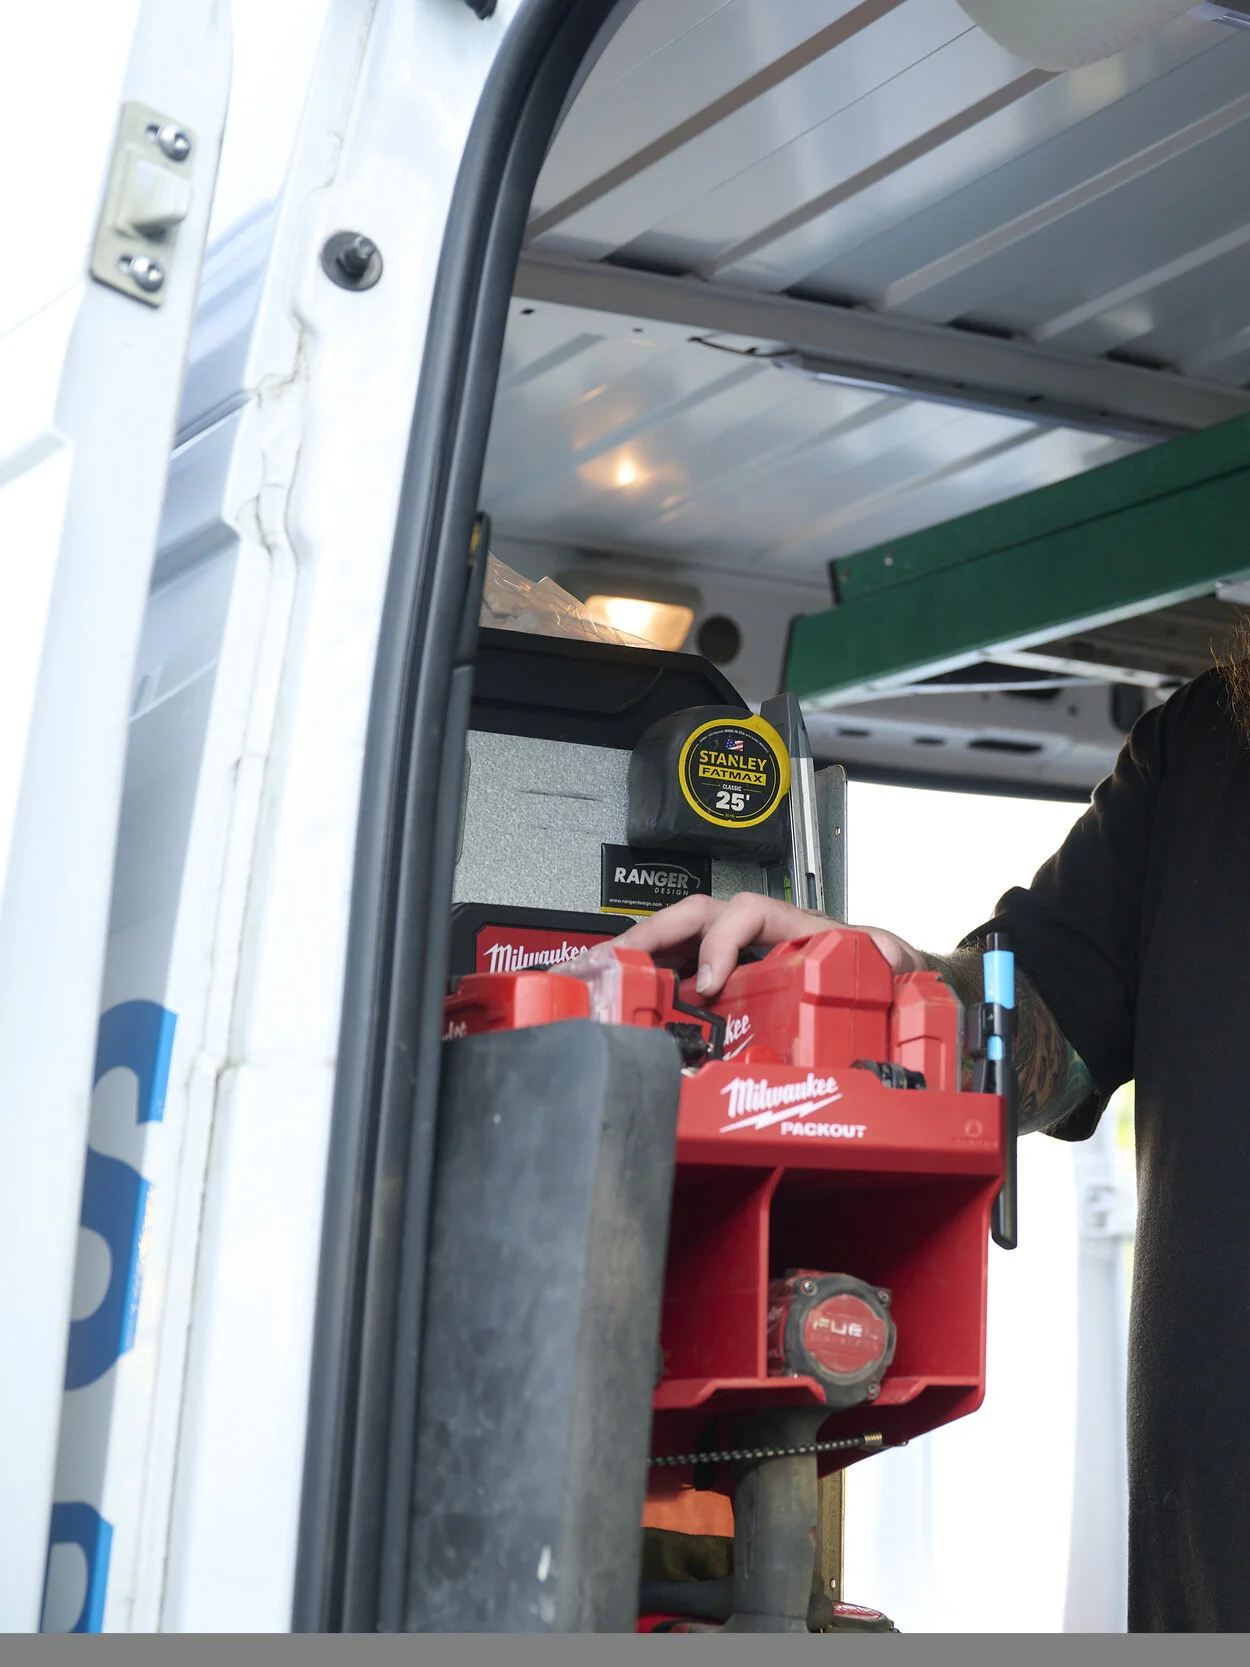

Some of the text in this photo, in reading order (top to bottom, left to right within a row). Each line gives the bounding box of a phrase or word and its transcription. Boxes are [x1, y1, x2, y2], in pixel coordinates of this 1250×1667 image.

[700, 749, 767, 771] STANLEY
[702, 767, 763, 783] FATMAX
[722, 784, 742, 792] CLASSIC
[614, 867, 689, 889] RANGER
[654, 887, 689, 896] DESIGN
[609, 898, 663, 907] www.rangerdesign.com
[720, 1073, 839, 1119] Milwaukee
[780, 1121, 867, 1139] PACKOUT
